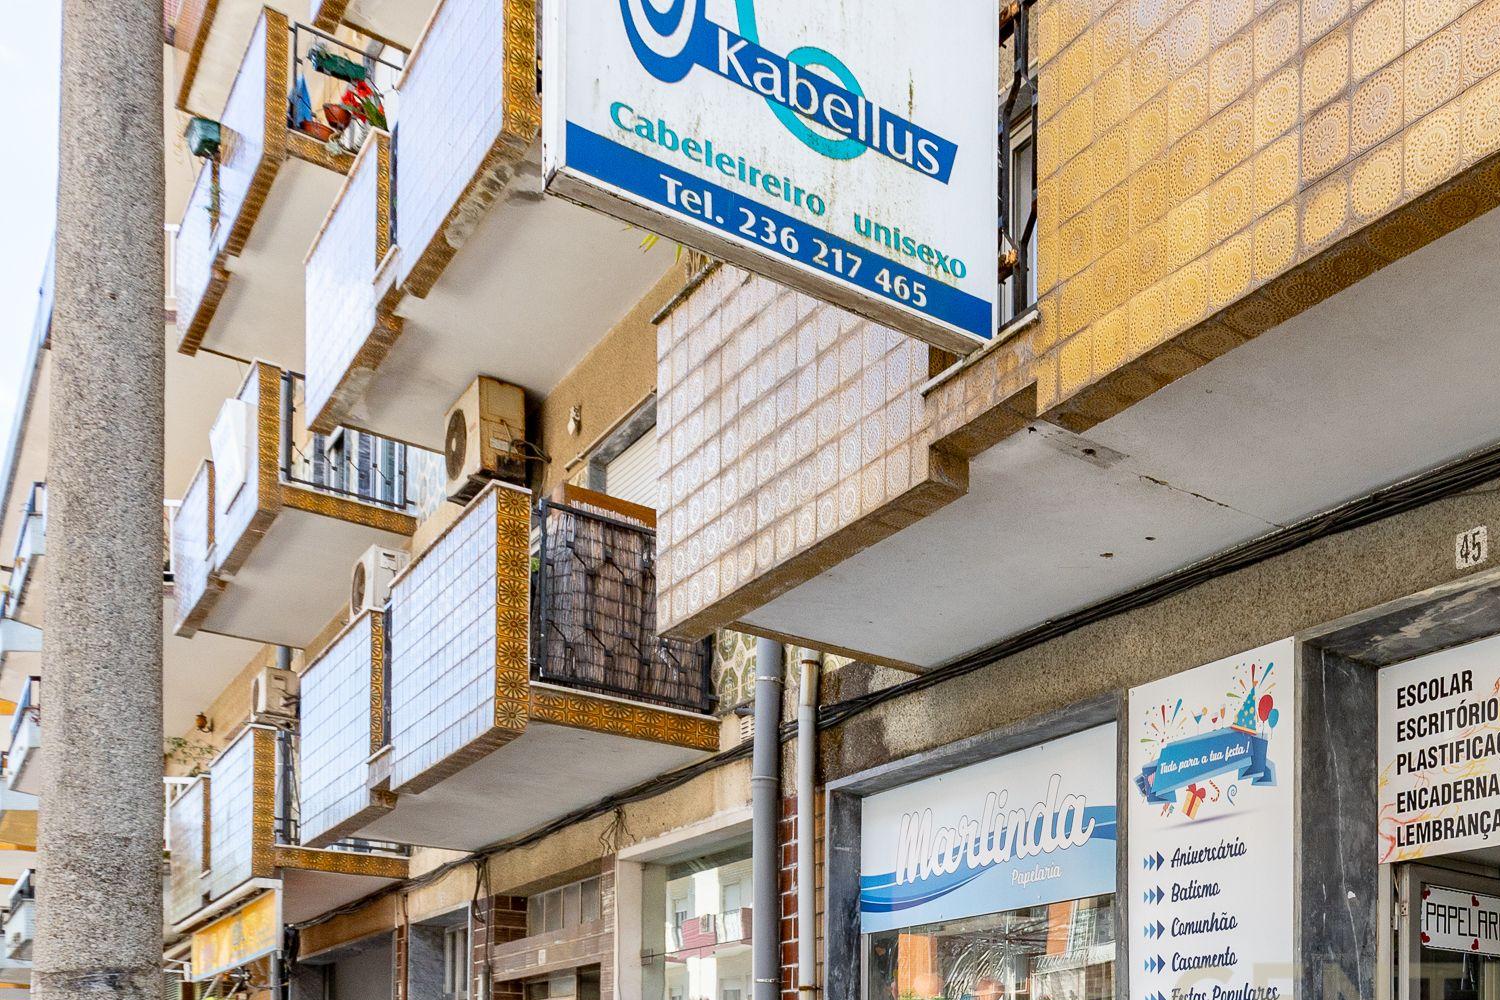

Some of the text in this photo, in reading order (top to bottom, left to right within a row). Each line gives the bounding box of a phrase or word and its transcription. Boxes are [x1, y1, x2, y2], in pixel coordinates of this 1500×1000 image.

[717, 27, 941, 176] Kabellus
[609, 100, 968, 280] Cabeleireiro unisexo
[659, 173, 929, 308] Tel. 236 217 465
[1459, 529, 1483, 565] 45
[1396, 669, 1474, 710] ESCOLAR
[1396, 697, 1500, 743] ESCRITÓRIO
[1160, 761, 1178, 775] Tudo
[1177, 757, 1201, 773] para
[1201, 755, 1209, 764] a
[1209, 750, 1225, 761] tua
[895, 772, 1096, 888] Marlinda
[1170, 837, 1248, 869] Aniversário
[1010, 862, 1063, 888] Papelaria
[1171, 879, 1221, 903] Batismo
[1171, 911, 1239, 938] Comunhão
[1172, 945, 1239, 972] Casamento
